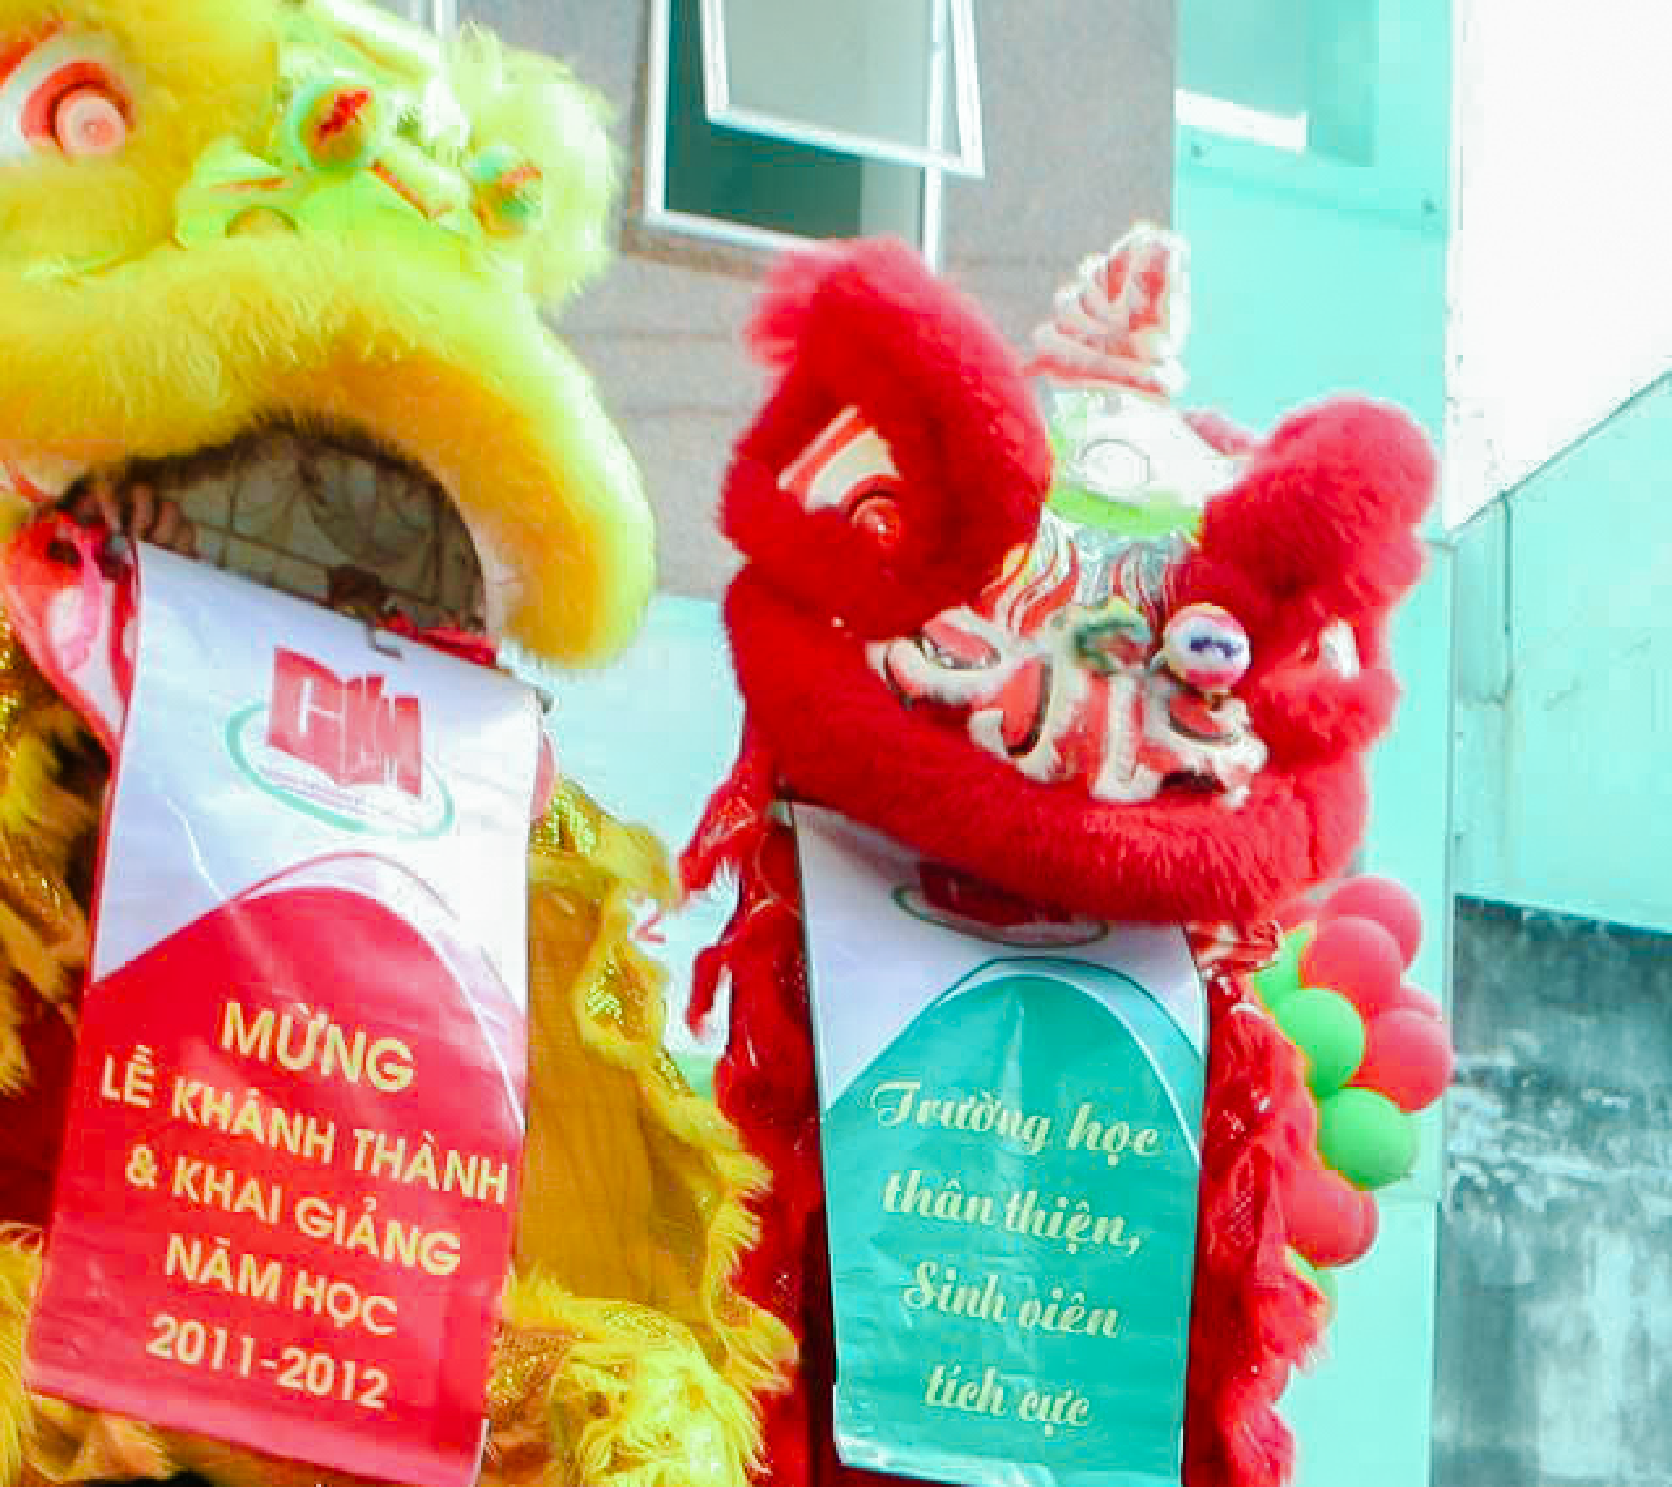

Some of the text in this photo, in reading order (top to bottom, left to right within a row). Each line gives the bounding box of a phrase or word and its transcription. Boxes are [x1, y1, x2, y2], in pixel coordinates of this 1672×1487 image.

[221, 990, 416, 1094] MỪNG
[101, 1046, 508, 1204] LỄ KHÁNH THÀNH
[869, 1080, 1160, 1166] Trường học
[125, 1146, 461, 1277] & KHAI GIẢNG
[883, 1171, 1142, 1255] thân thiện,
[165, 1230, 398, 1338] NĂM HỌC
[903, 1262, 1120, 1338] Sinh viên
[146, 1316, 389, 1410] 2011-2012
[924, 1362, 1005, 1418] tích
